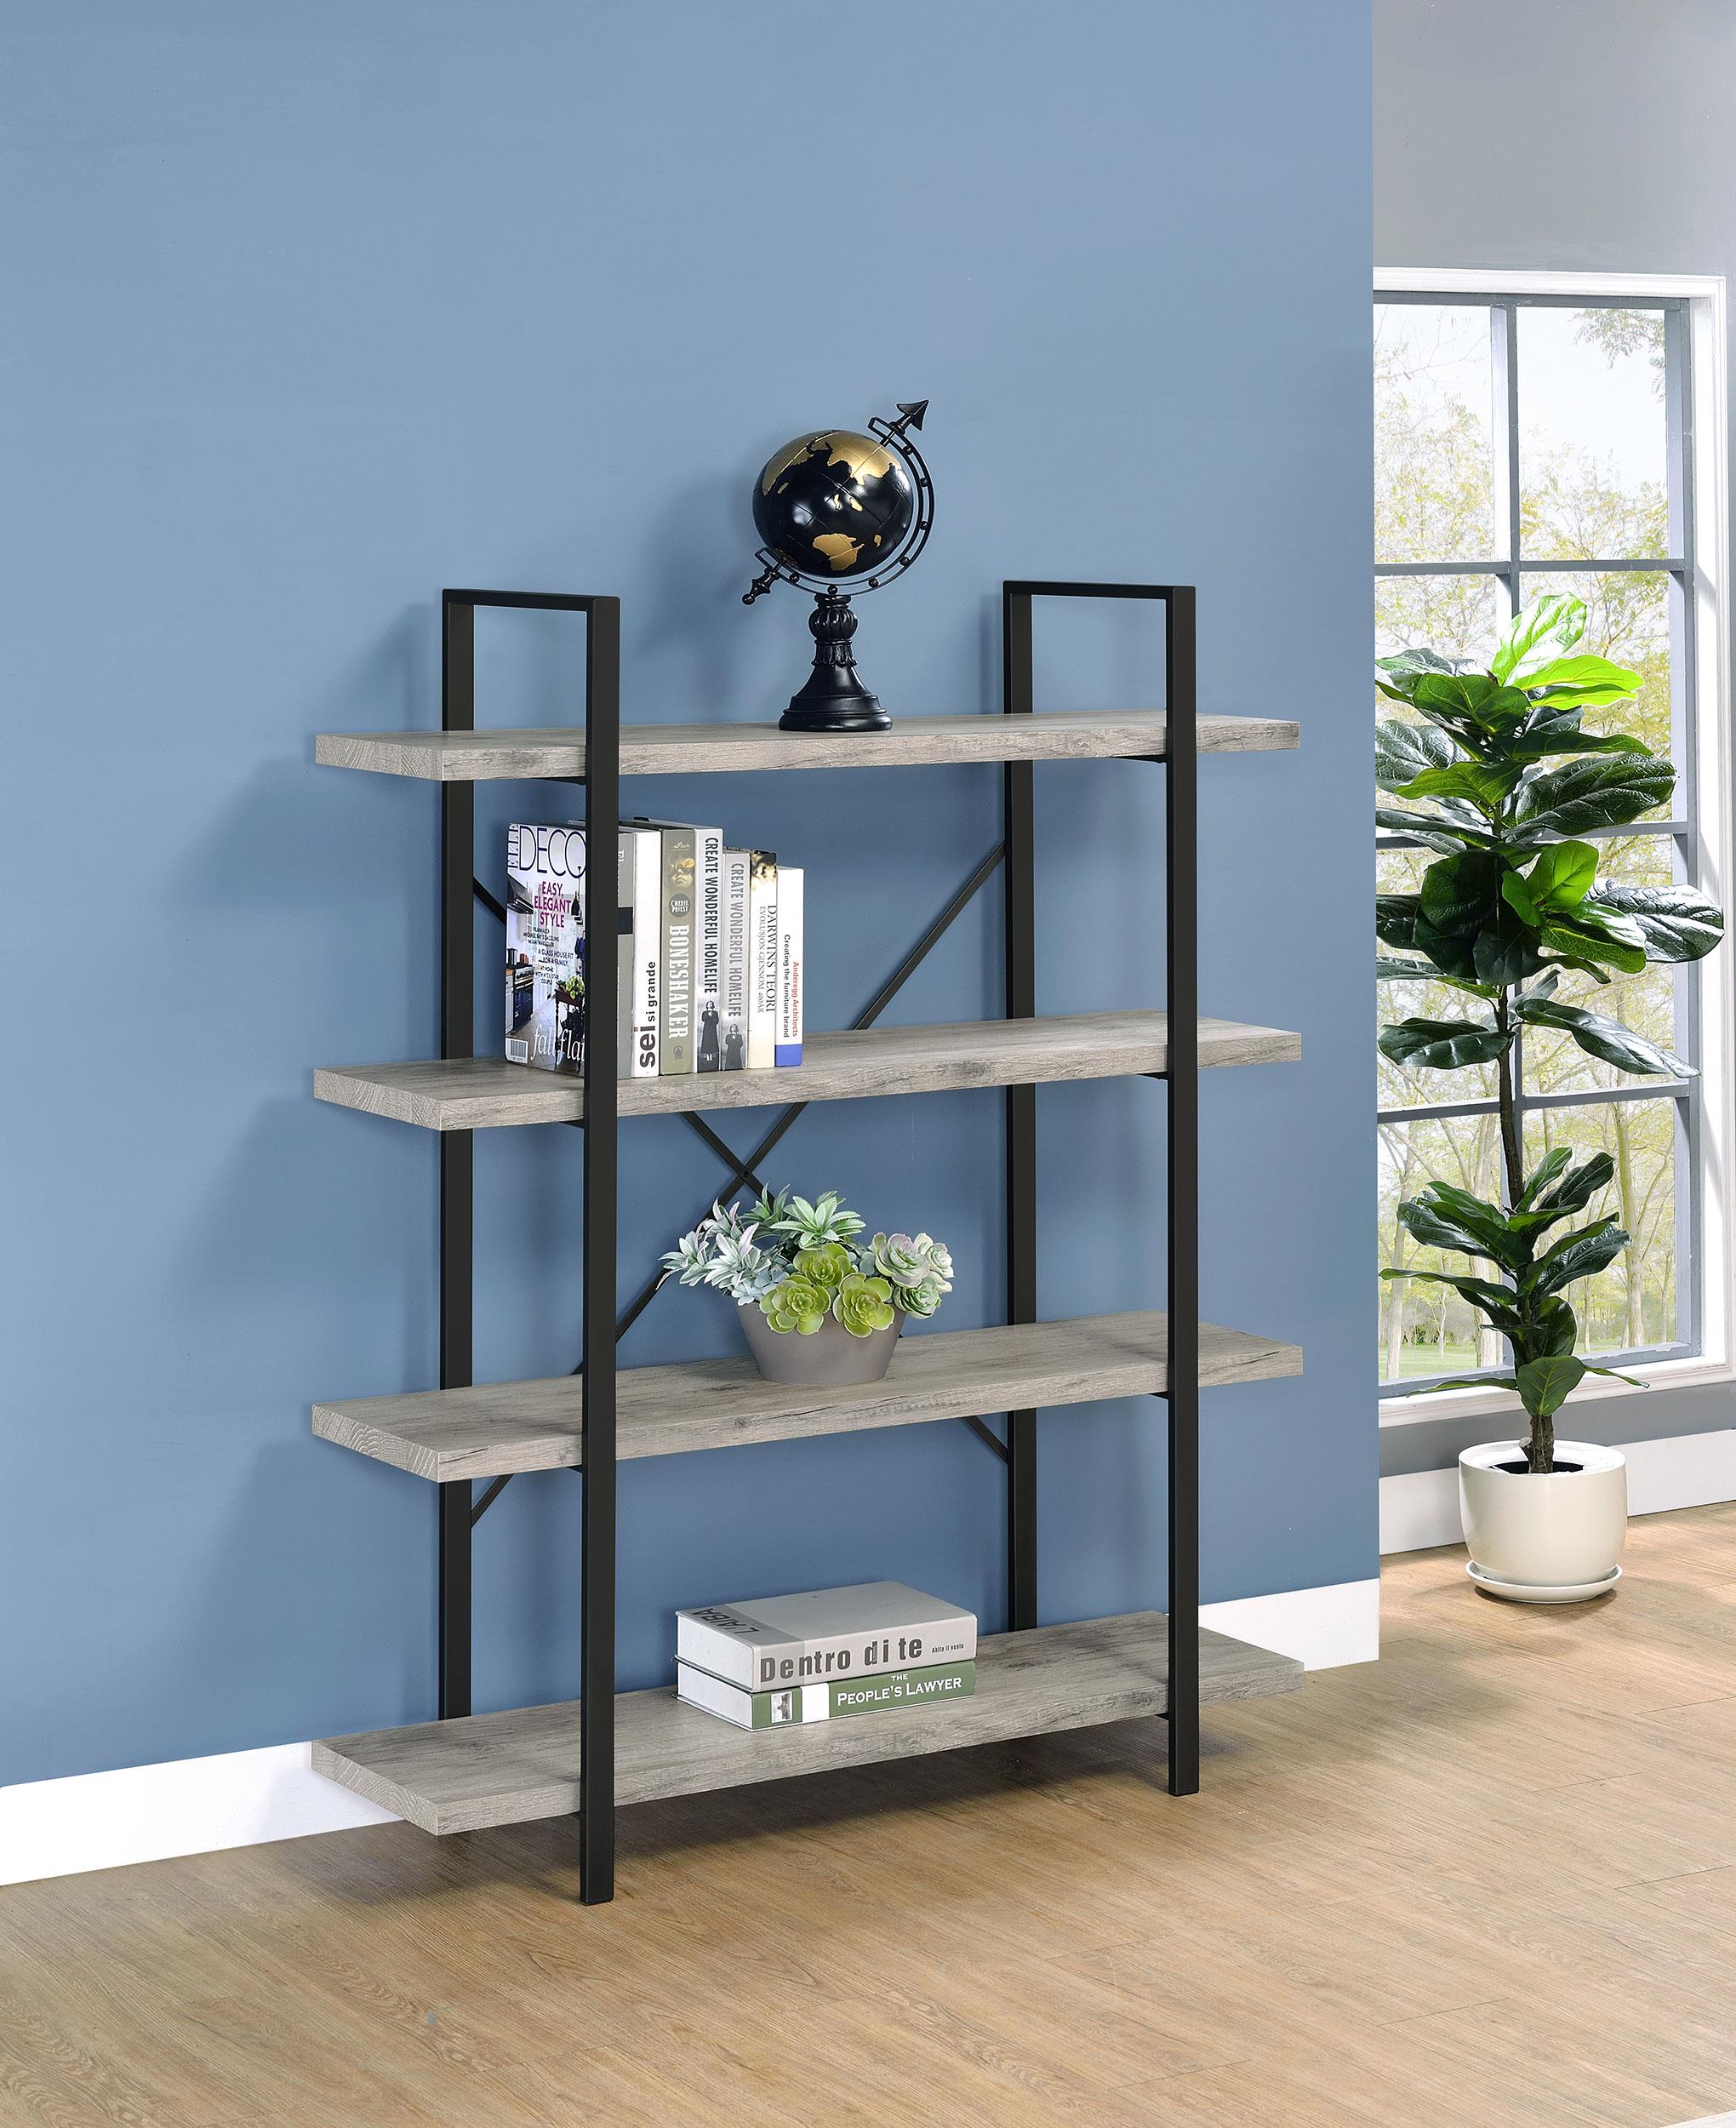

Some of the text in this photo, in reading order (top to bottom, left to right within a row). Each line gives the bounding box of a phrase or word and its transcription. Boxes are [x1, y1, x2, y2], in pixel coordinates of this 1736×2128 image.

[519, 826, 585, 878] DECO
[534, 895, 571, 913] ELEGANT
[542, 881, 563, 897] EASY,
[540, 912, 564, 928] STYLE
[704, 837, 718, 993] CREATE WONDERFUL HOMELIFE
[728, 863, 745, 1017] CREATE WONDERFUL HOMELIFE
[766, 905, 776, 1012] DARWINS TEORI
[647, 961, 658, 1007] grande
[668, 924, 689, 1038] BONESHAKER
[646, 1011, 655, 1021] si
[557, 1028, 585, 1065] flai
[761, 1638, 922, 1682] Dentro di te
[891, 1673, 909, 1682] THE
[837, 1677, 962, 1707] PEOPLE'S LAWYER
